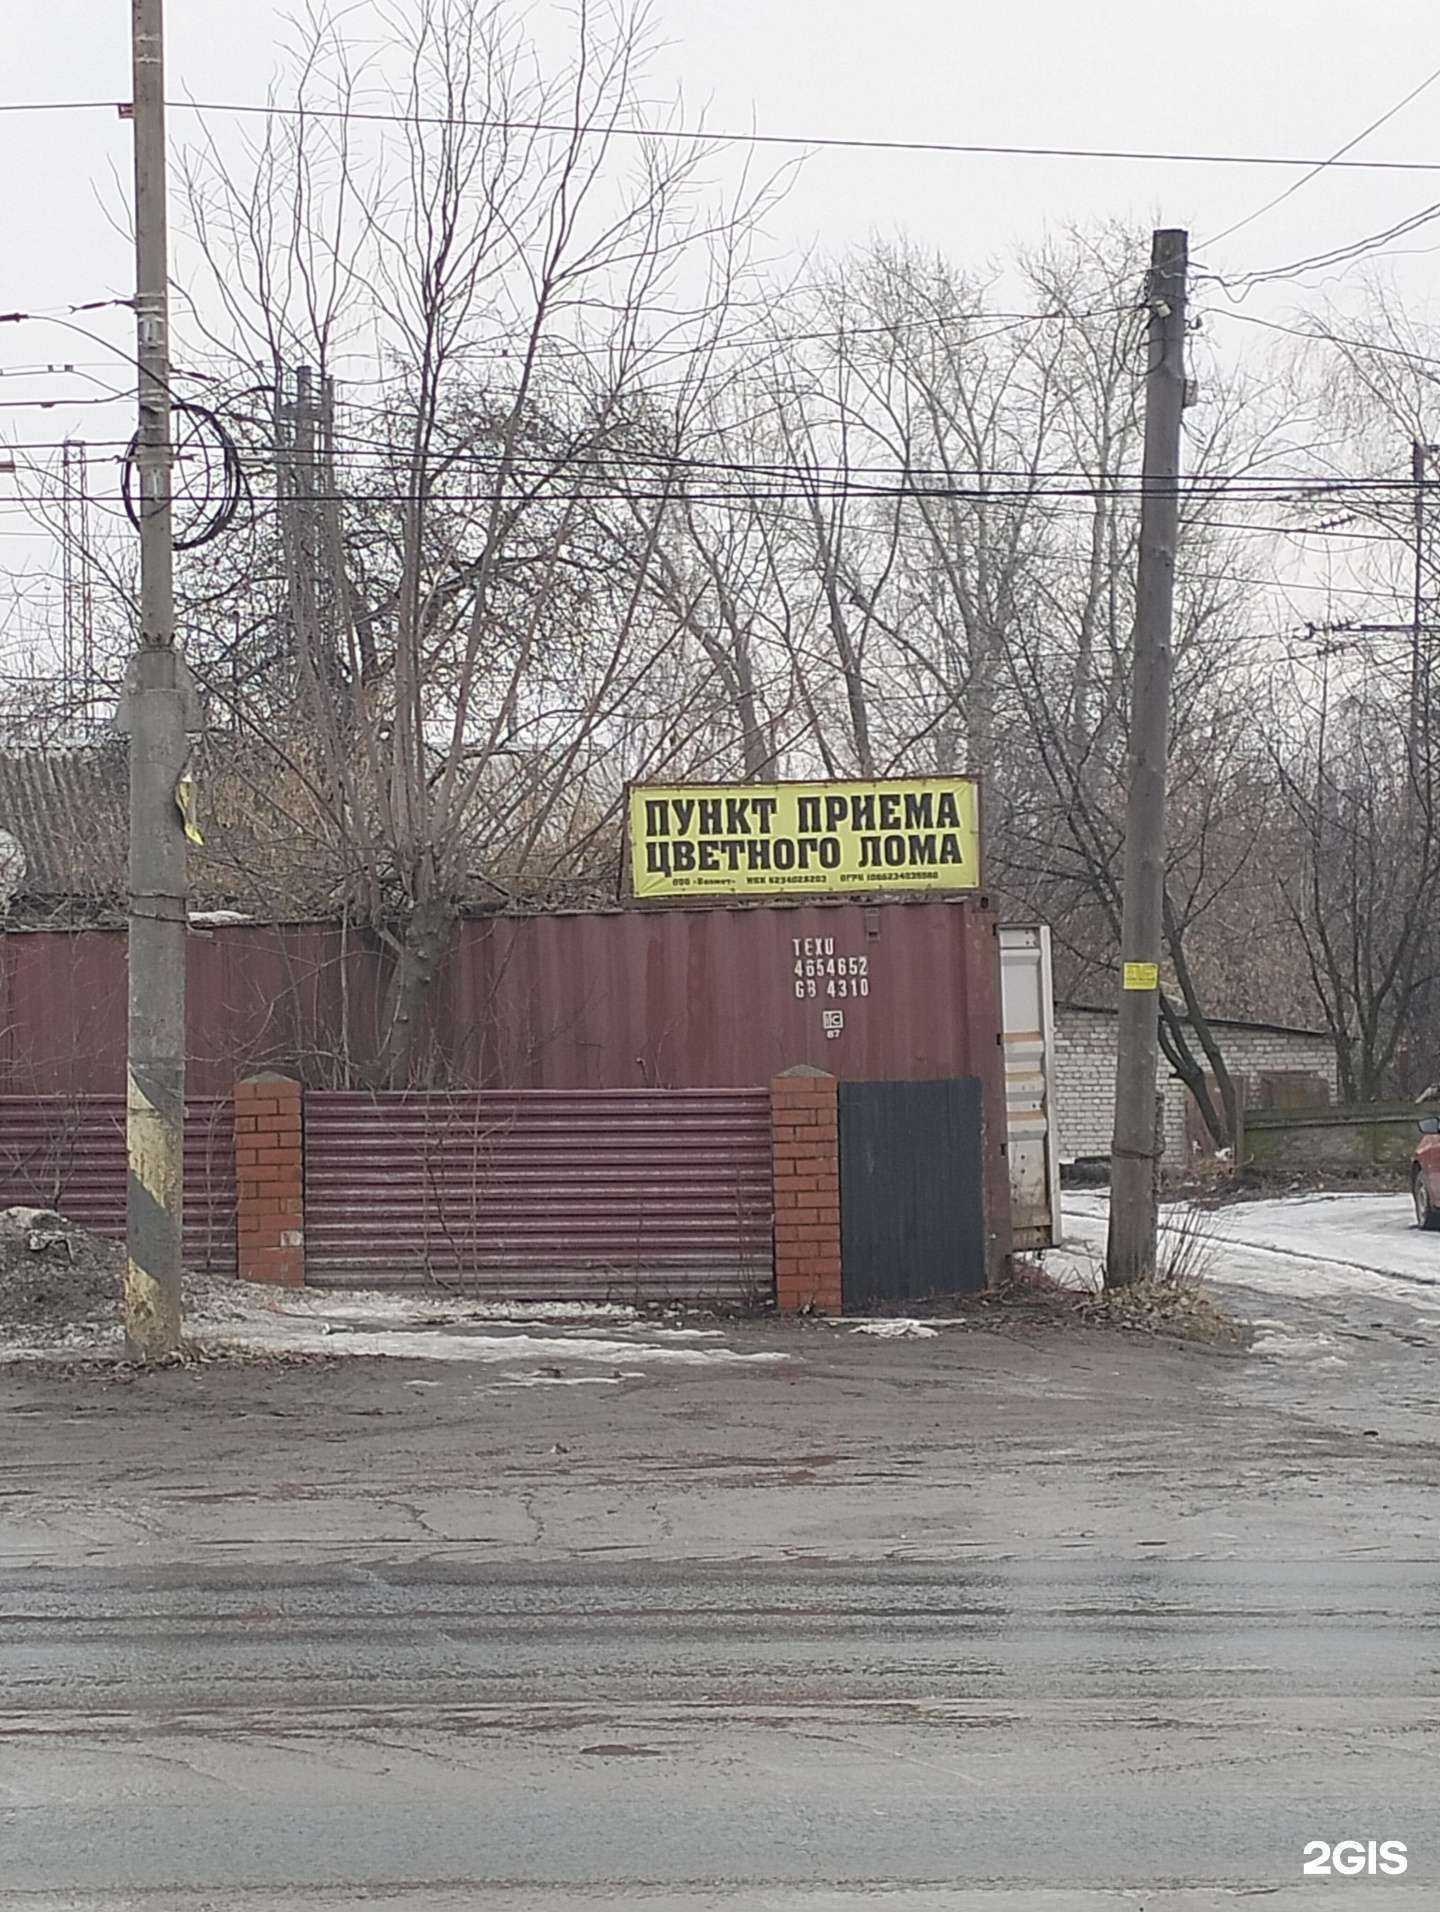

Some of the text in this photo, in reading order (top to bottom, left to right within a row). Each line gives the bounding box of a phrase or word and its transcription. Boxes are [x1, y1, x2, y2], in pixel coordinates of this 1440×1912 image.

[645, 792, 960, 837] ПУНКТ ПРИЕМА
[645, 833, 963, 877] ЦВЕТНОГО ЛОМА
[792, 938, 834, 956] TEXU
[794, 956, 869, 977] 4654652
[826, 977, 870, 998] 4310
